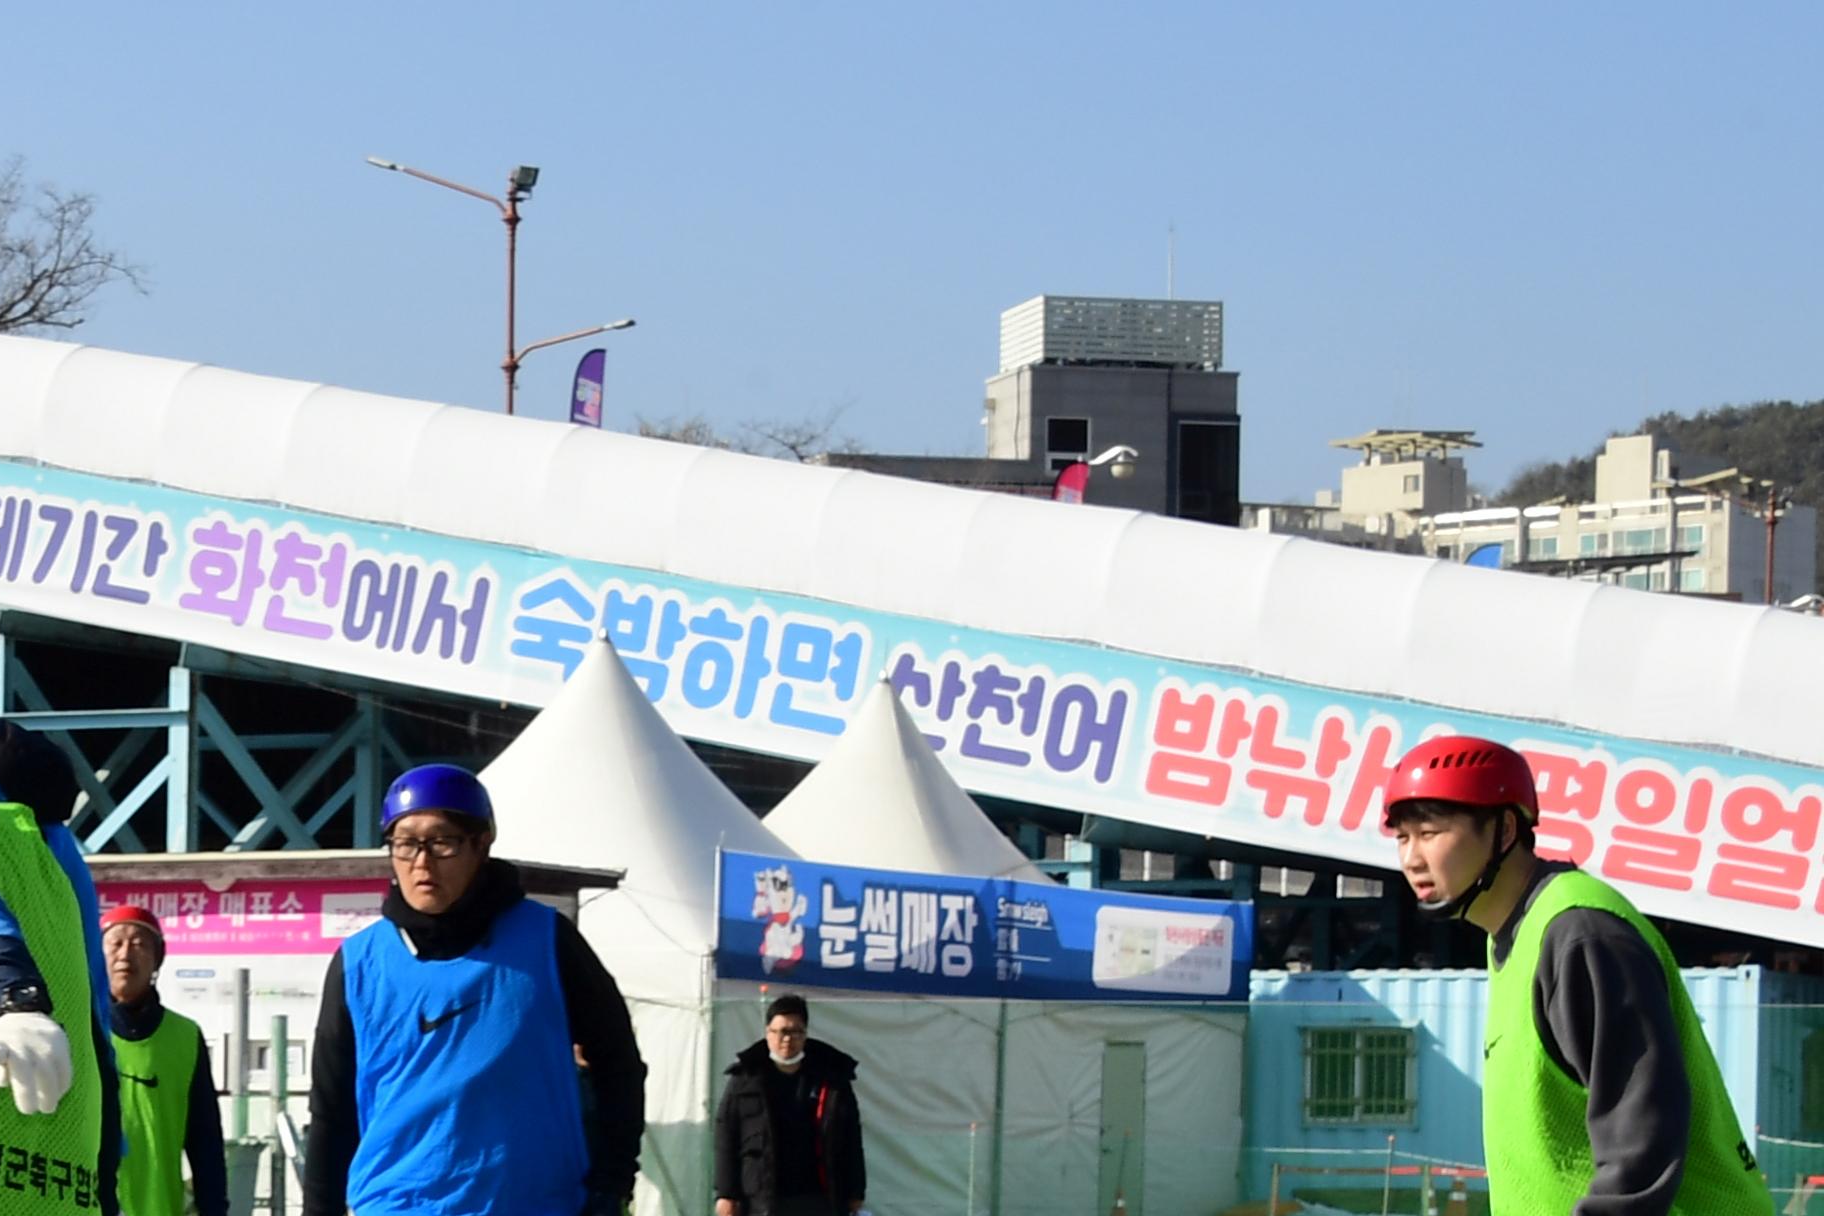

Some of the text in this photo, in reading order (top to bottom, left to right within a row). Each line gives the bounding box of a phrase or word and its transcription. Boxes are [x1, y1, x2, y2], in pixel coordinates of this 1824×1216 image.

[178, 520, 490, 665] 화천에서
[890, 652, 1128, 784] 산천어
[219, 891, 305, 928] 매표소
[819, 882, 978, 977] 눈썰매장
